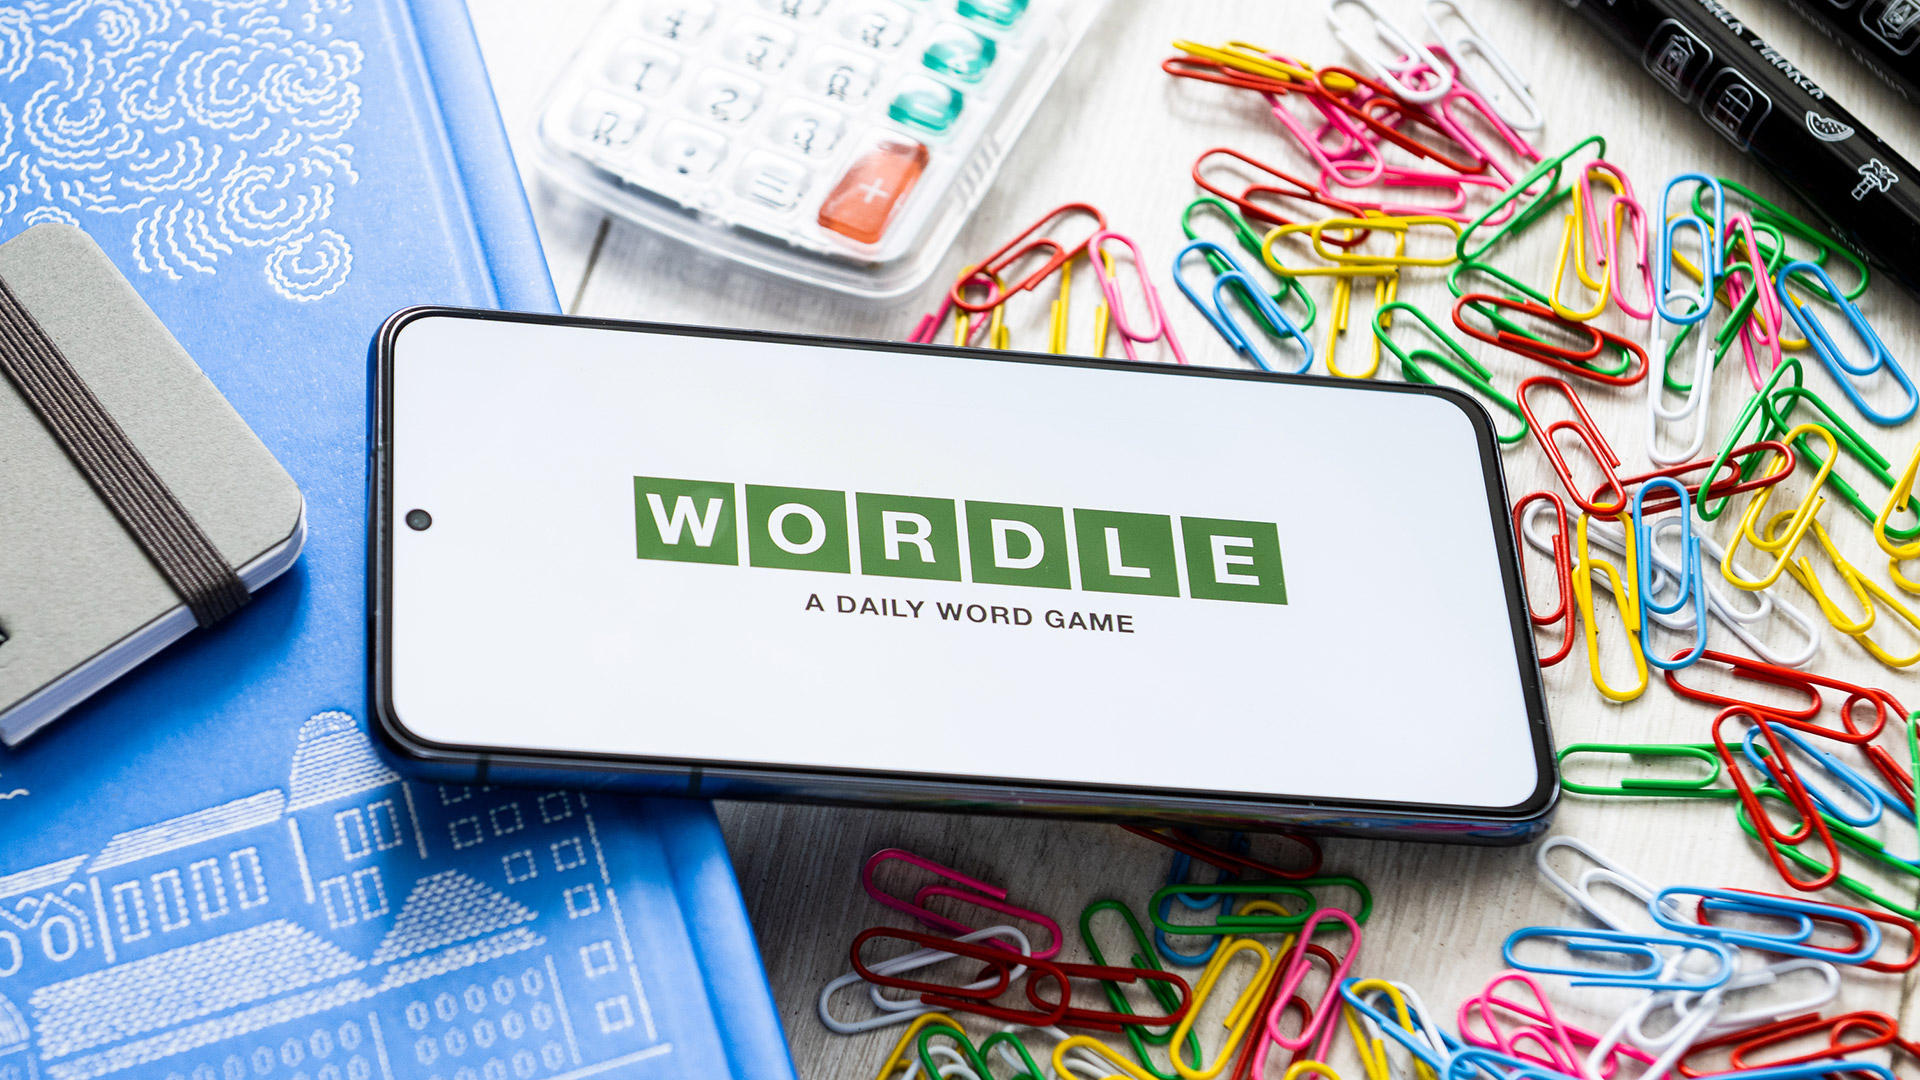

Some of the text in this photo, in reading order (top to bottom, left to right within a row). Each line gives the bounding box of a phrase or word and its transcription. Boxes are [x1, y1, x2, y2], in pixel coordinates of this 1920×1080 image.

[646, 493, 1260, 586] WORDLE
[805, 593, 1135, 634] A DAILY WORD GAME
